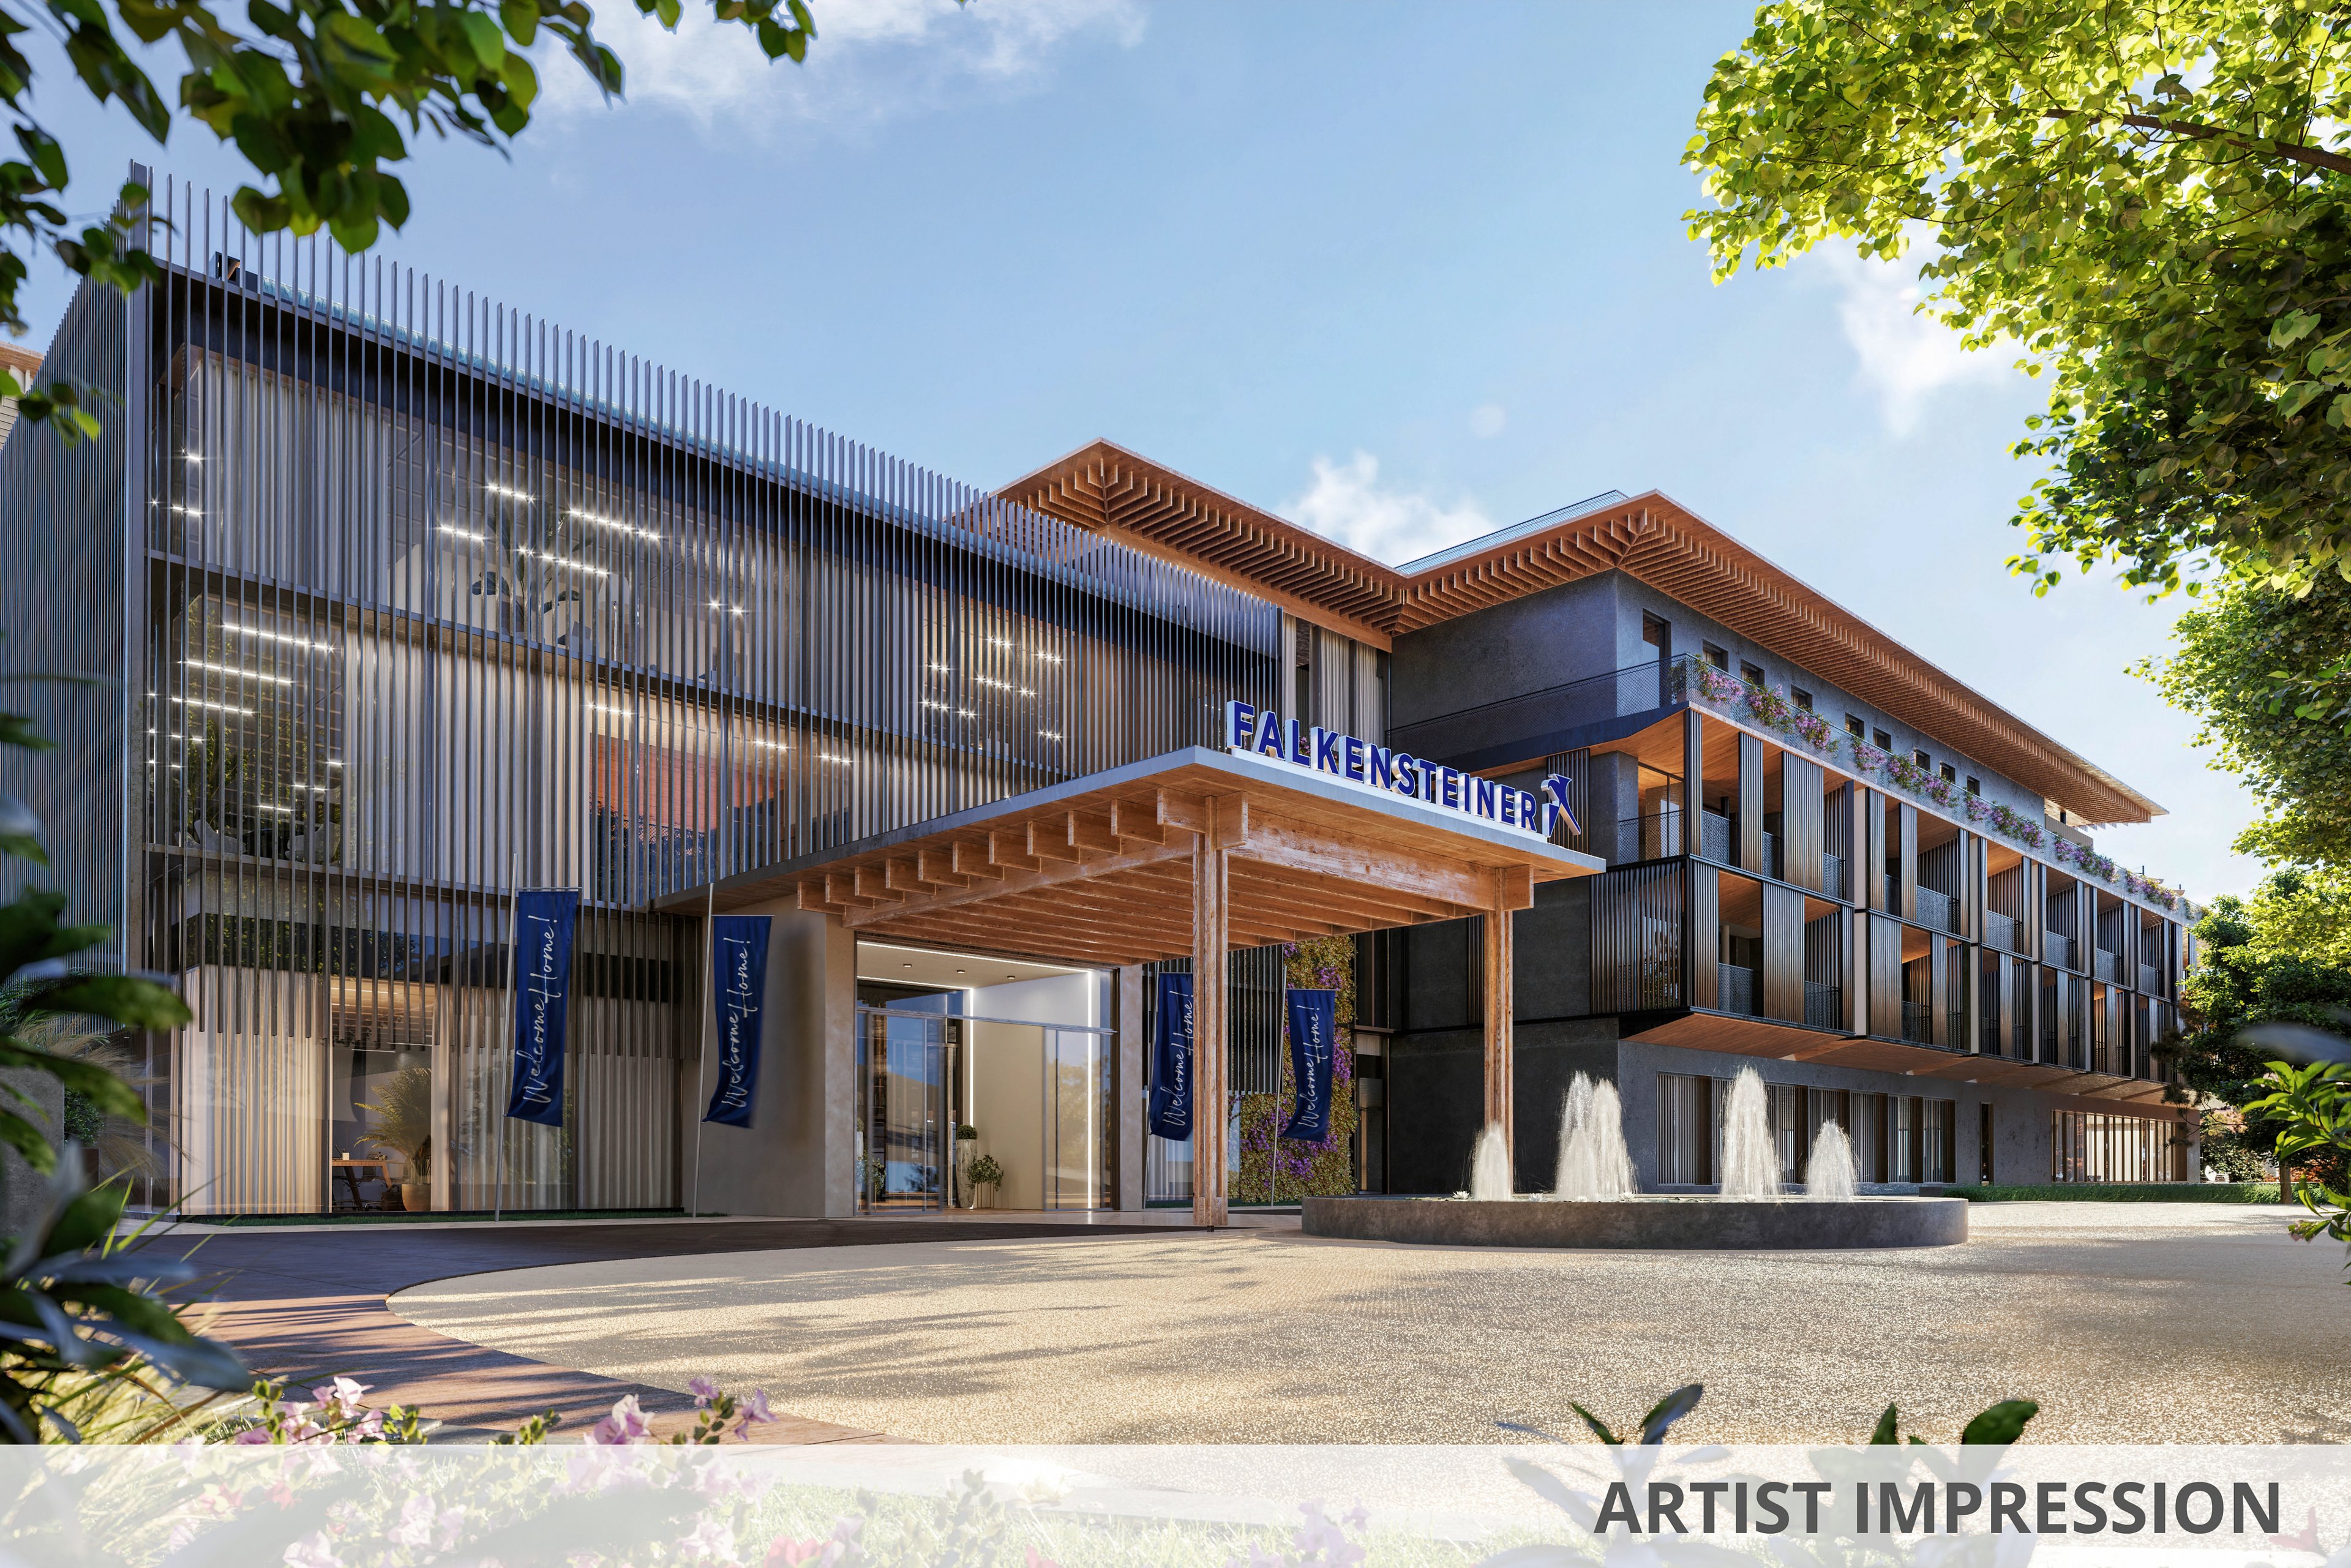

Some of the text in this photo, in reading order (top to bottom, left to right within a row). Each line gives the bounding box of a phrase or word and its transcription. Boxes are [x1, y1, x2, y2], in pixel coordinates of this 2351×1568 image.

[1226, 700, 1537, 833] FALKENSTEINER
[516, 915, 562, 1103] Welcome Home!
[721, 937, 758, 1108] Welcome Home!
[1296, 1005, 1329, 1128] Welcome Home!
[1160, 1049, 1186, 1127] Welcome
